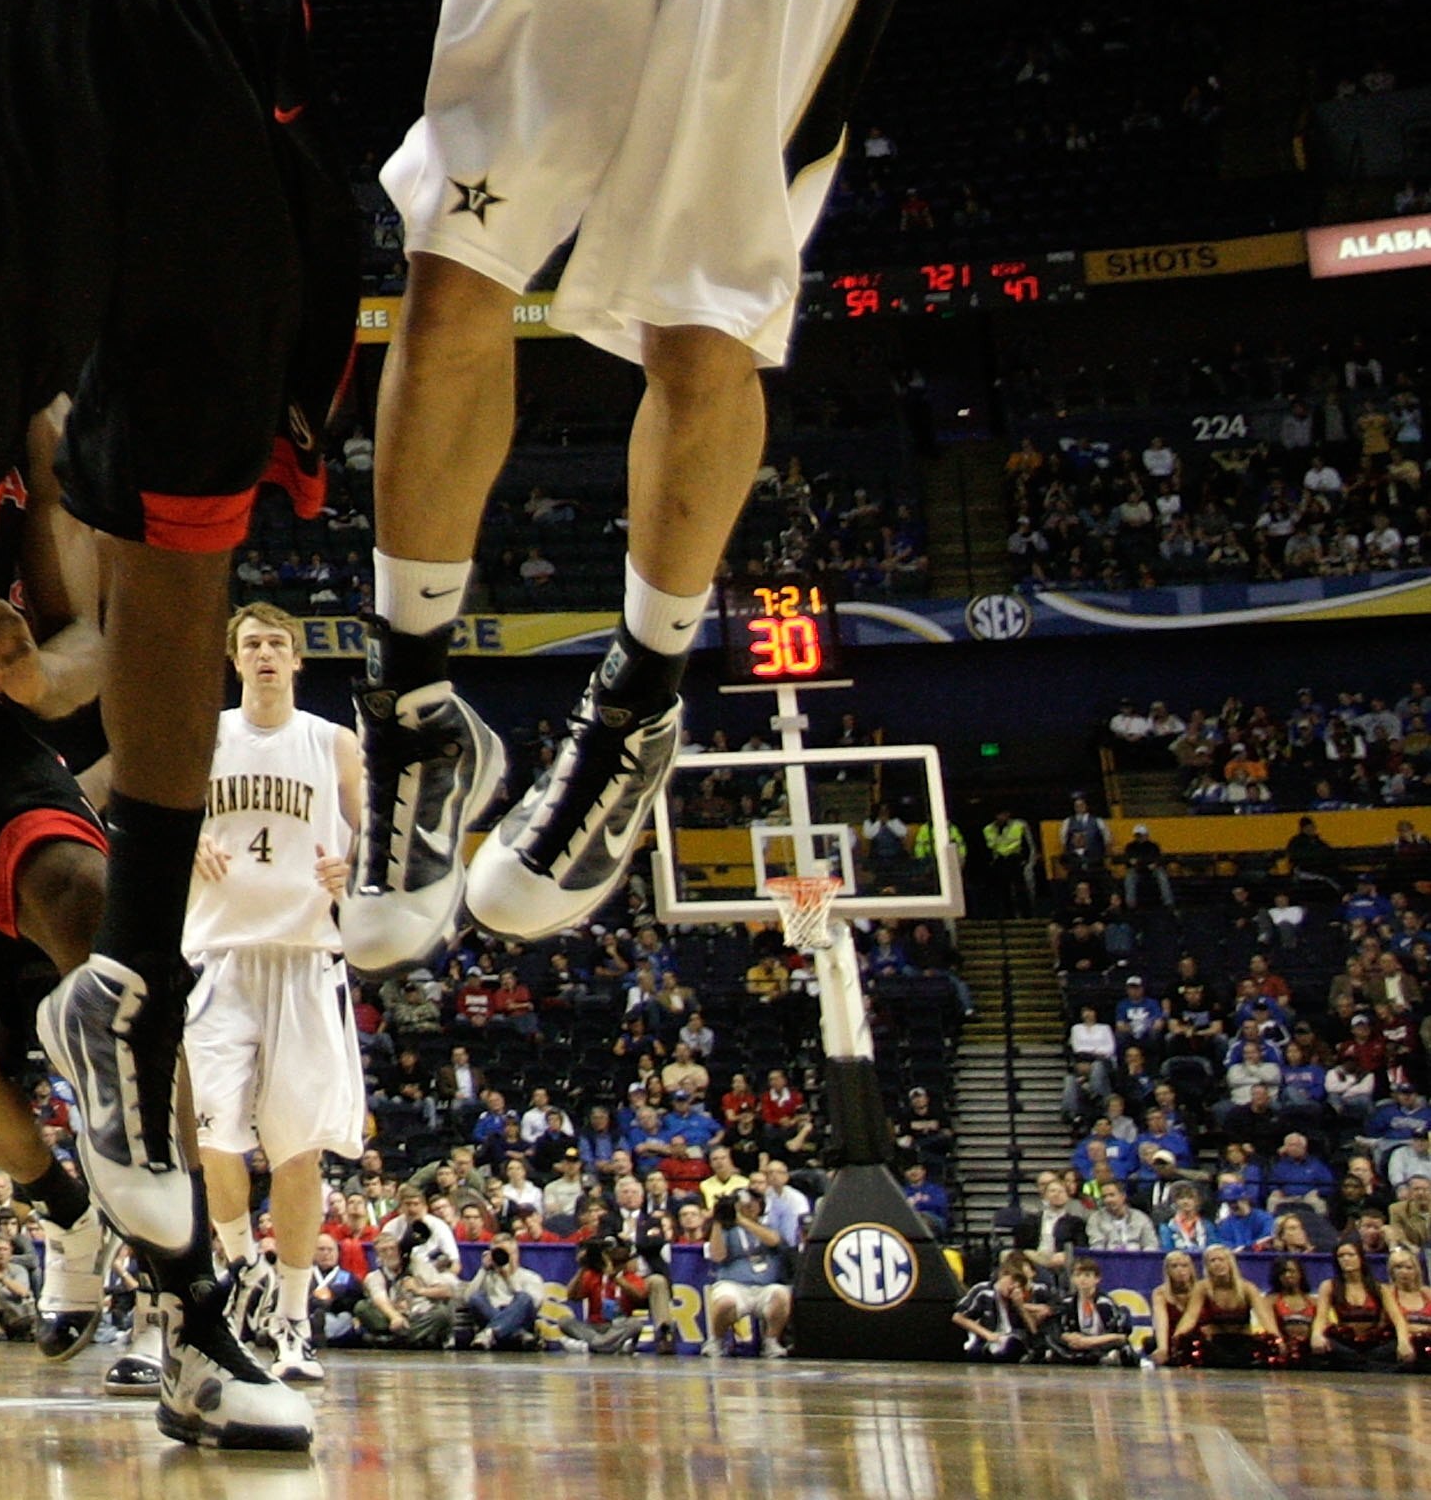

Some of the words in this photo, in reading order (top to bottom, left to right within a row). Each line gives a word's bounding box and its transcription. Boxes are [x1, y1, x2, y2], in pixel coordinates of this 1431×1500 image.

[1106, 245, 1219, 277] SHOTS
[1191, 414, 1247, 441] 224
[753, 585, 821, 618] 7:21
[972, 594, 1025, 640] SEC
[748, 615, 821, 676] 30
[247, 826, 273, 863] 4
[831, 1227, 912, 1305] SEC
